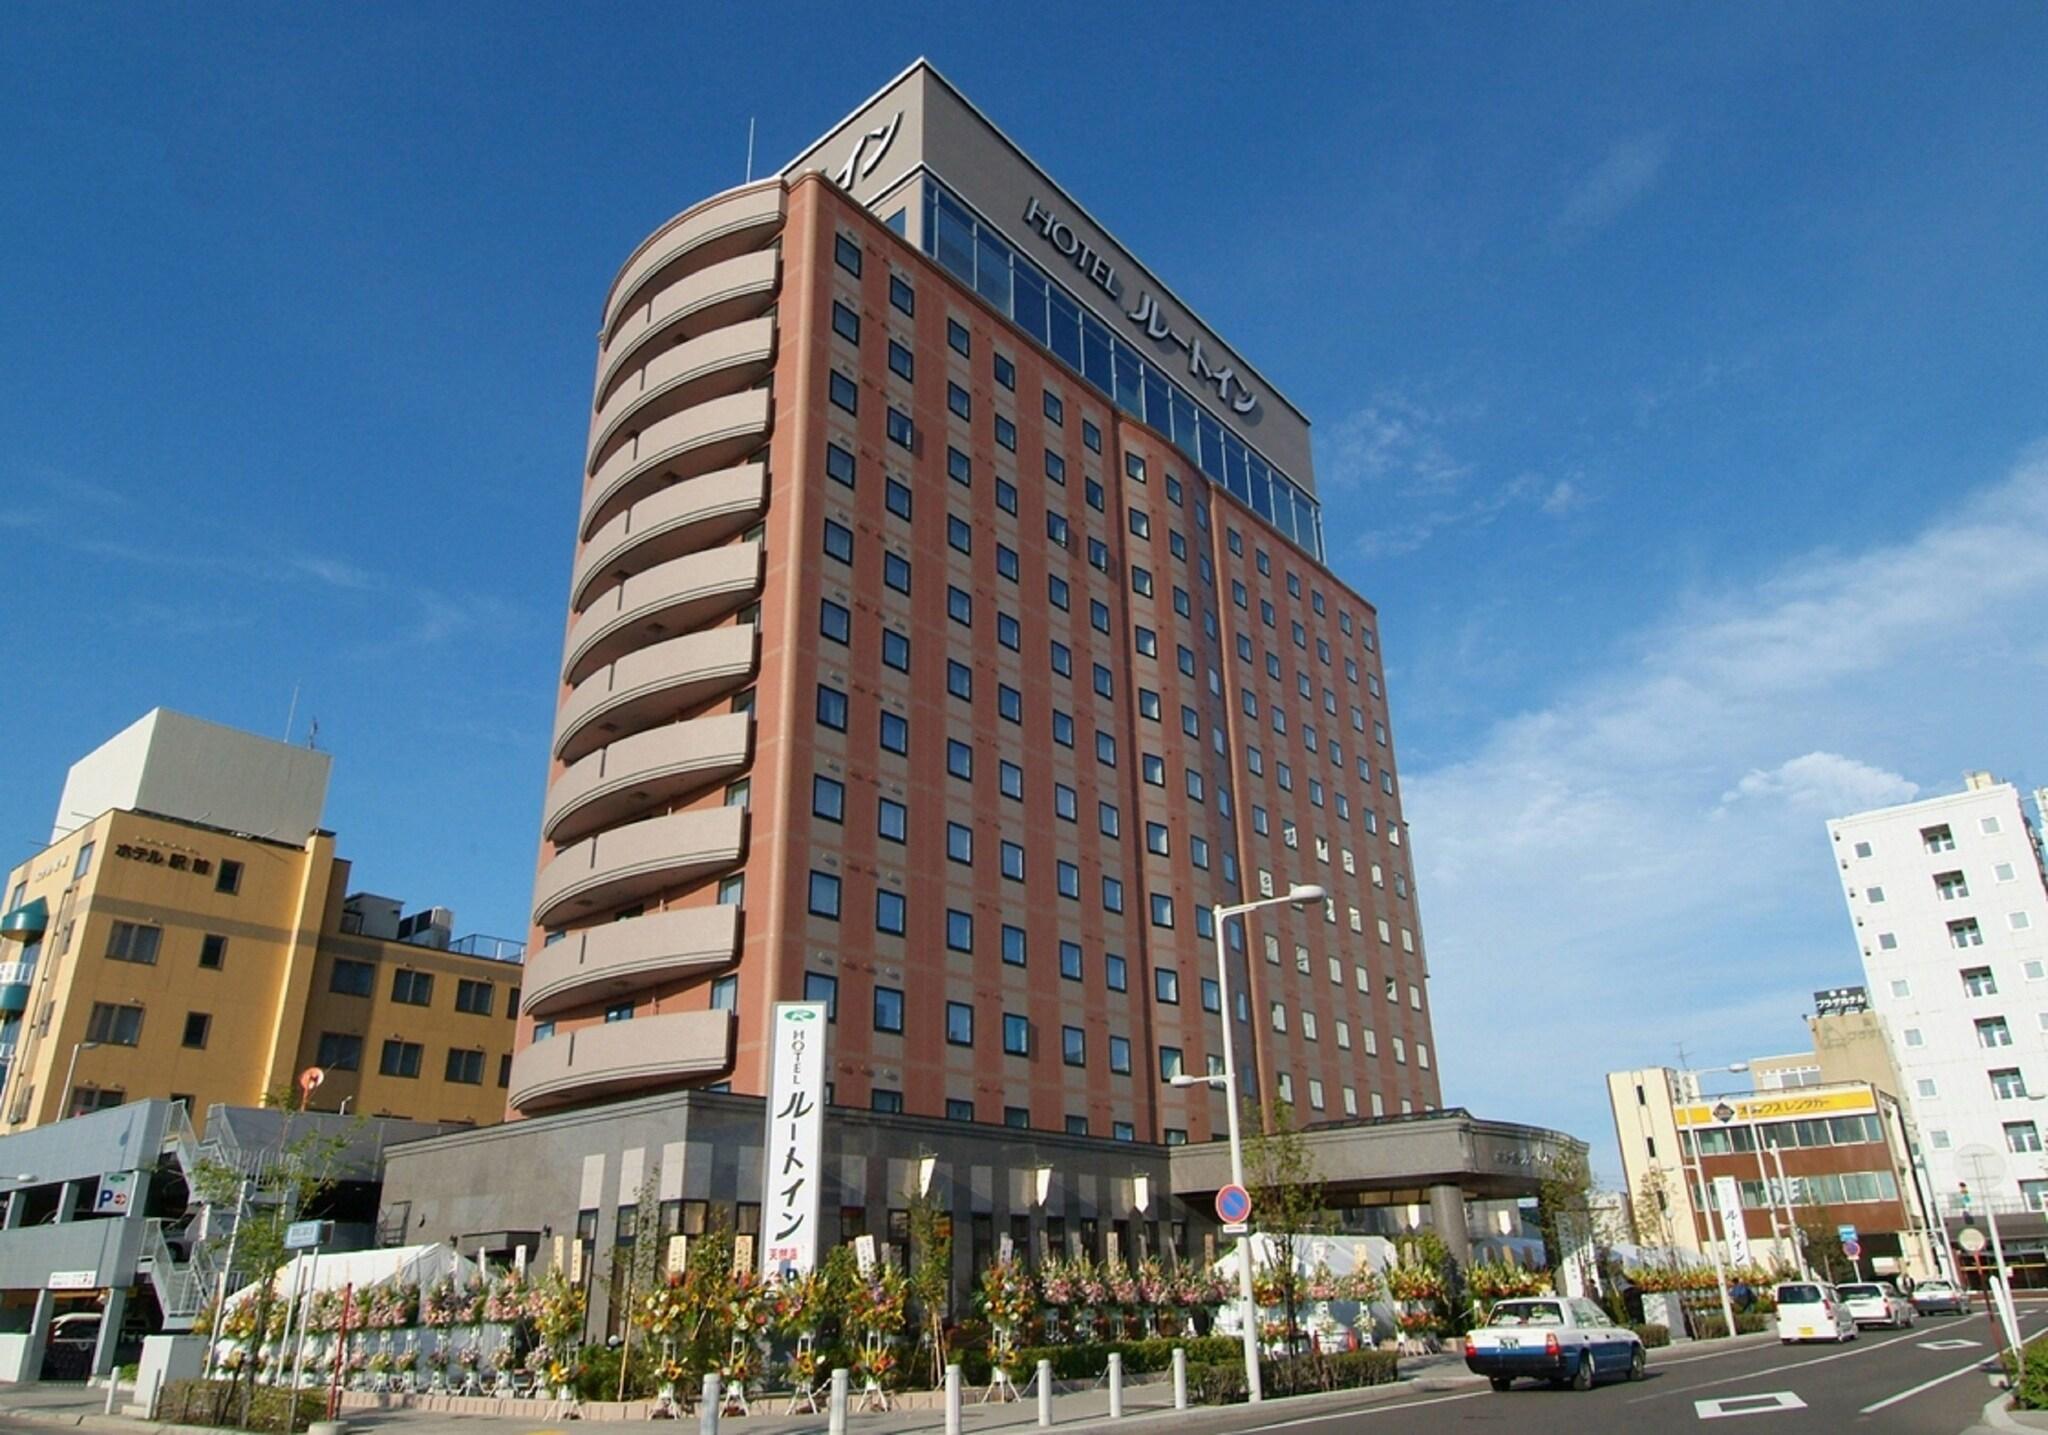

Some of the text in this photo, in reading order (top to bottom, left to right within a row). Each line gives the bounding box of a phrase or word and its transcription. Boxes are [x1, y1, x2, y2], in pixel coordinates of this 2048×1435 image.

[1023, 197, 1258, 413] HOTEL ルートイン
[791, 1030, 806, 1085] HOTEL
[1738, 1099, 1831, 1117] オックスレンタカー
[775, 1091, 815, 1241] ルートイン
[98, 1190, 113, 1208] P
